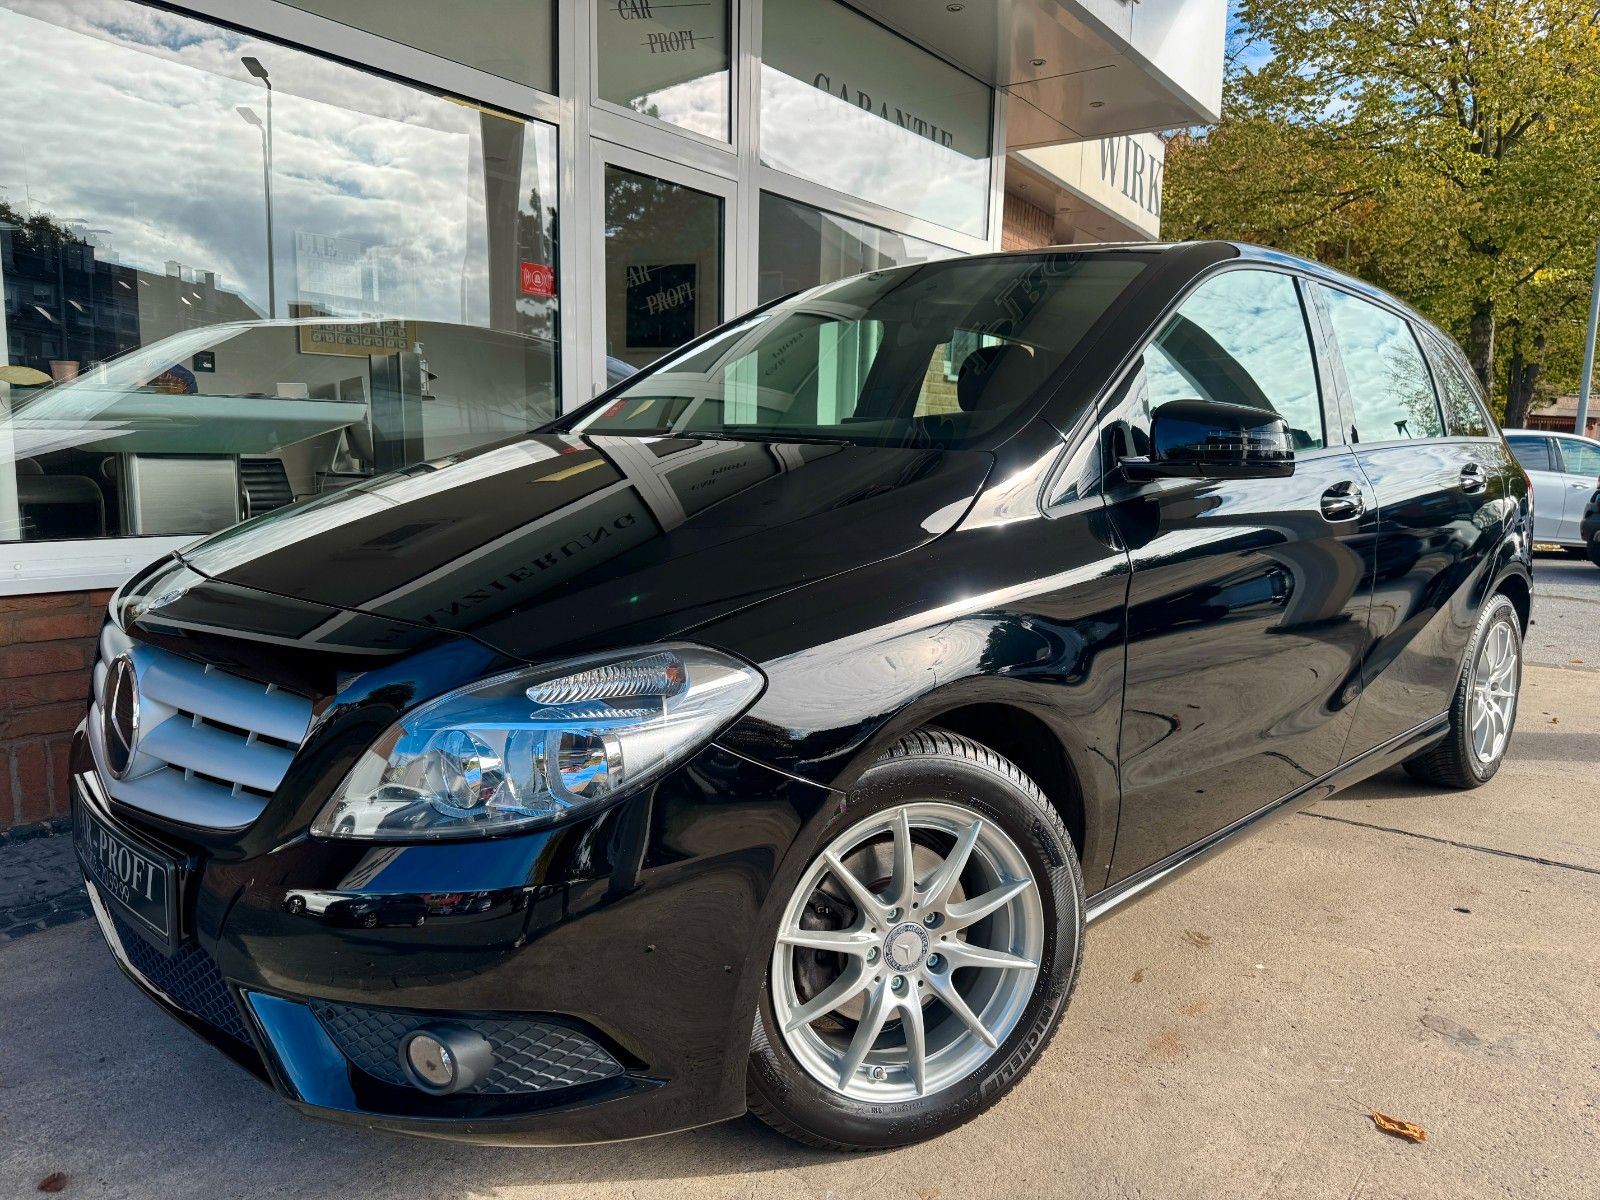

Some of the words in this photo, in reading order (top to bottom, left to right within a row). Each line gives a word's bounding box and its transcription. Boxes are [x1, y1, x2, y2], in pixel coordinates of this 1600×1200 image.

[617, 0, 653, 20] CAR
[647, 29, 696, 54] PROFI
[1100, 134, 1164, 218] WIRK
[645, 281, 694, 316] PROFI
[984, 1003, 1055, 1097] MICHELIN
